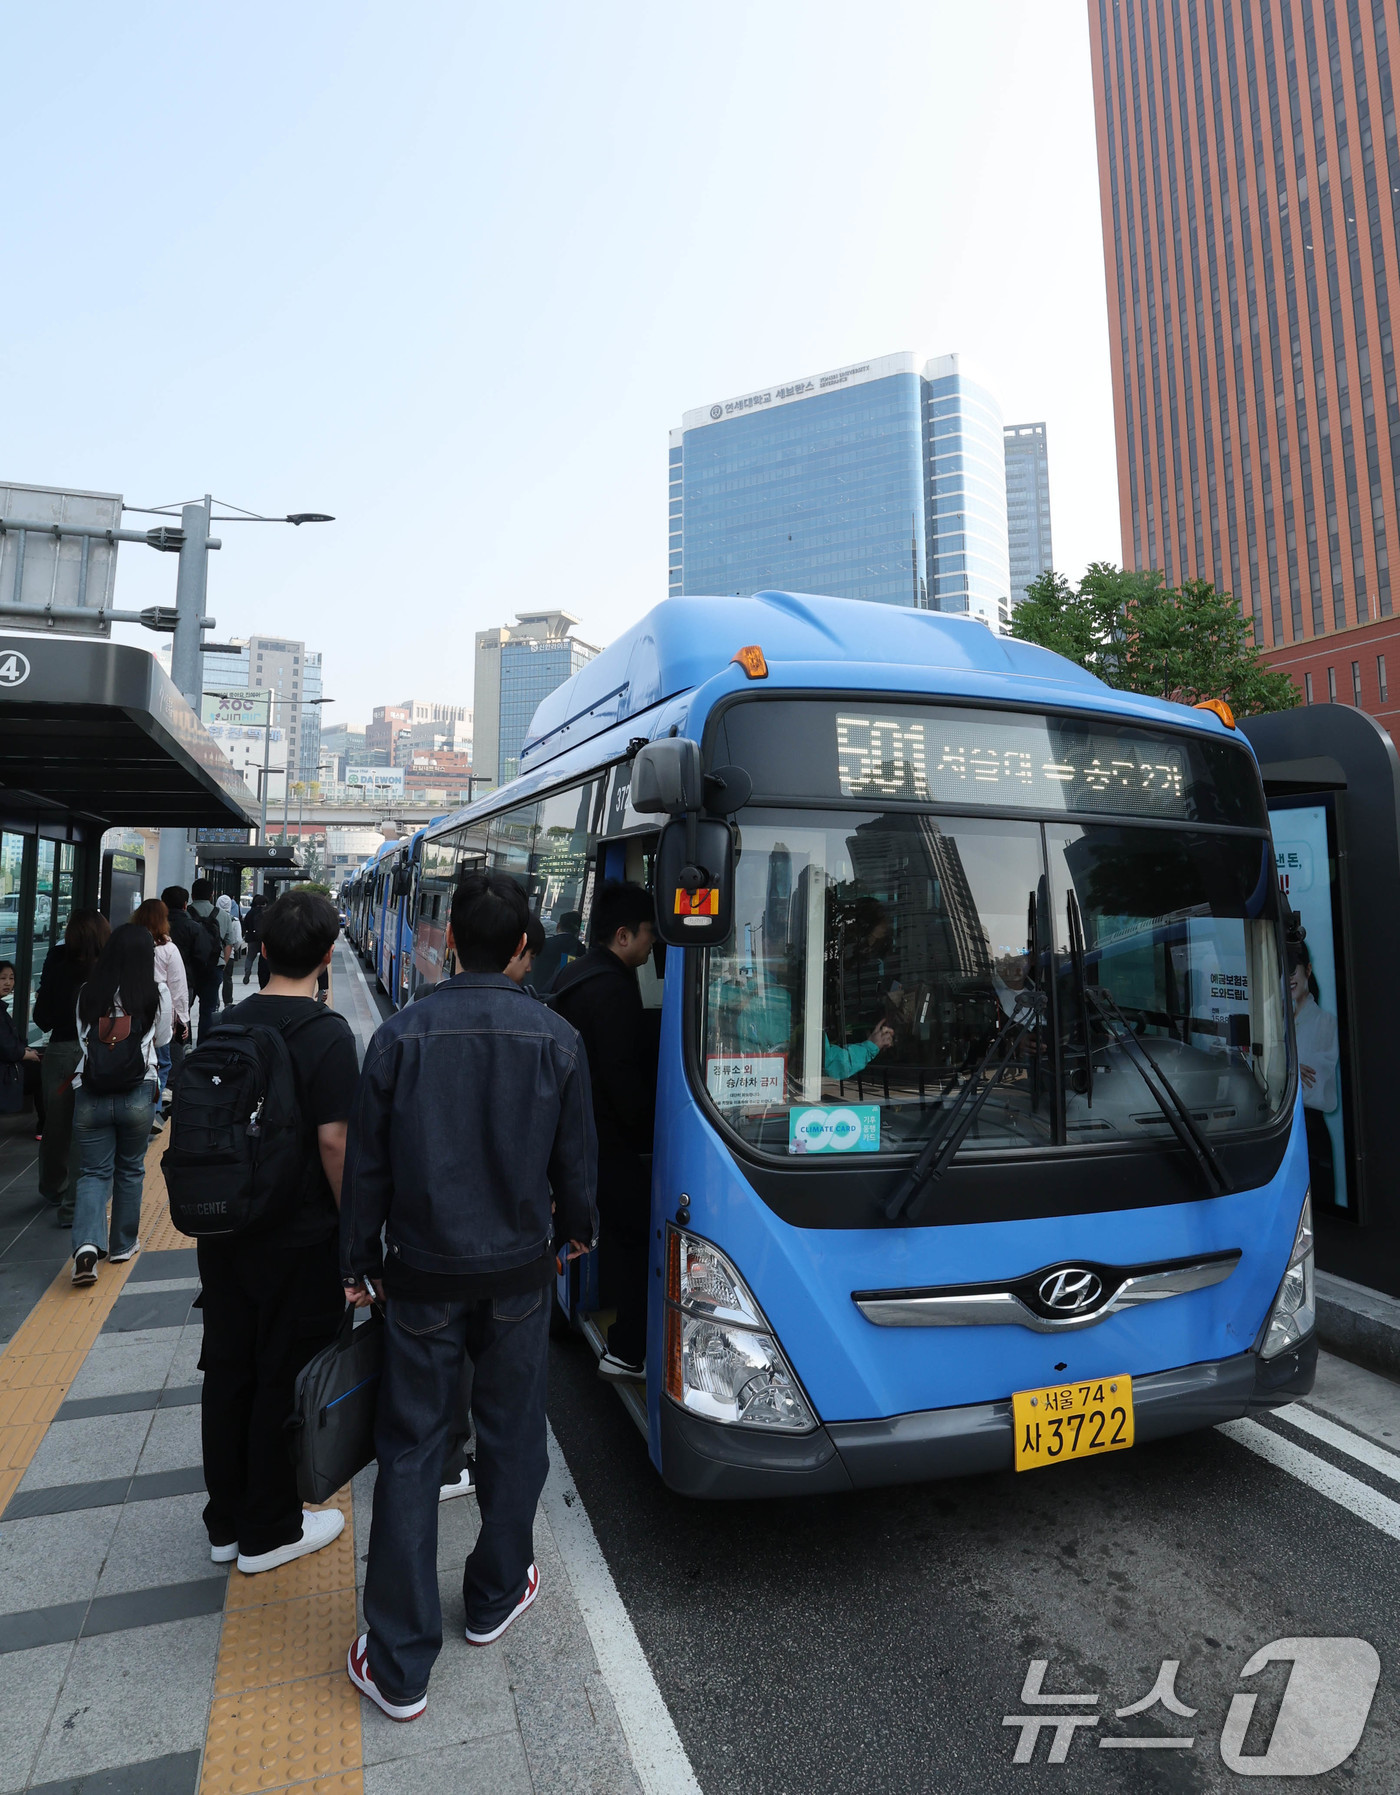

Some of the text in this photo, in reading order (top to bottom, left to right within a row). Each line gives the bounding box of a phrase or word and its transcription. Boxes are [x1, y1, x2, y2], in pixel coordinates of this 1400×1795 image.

[725, 381, 815, 414] 연세대학교 세브란스
[539, 642, 569, 651] 신한라이프
[836, 717, 928, 795] 501
[360, 775, 402, 785] DAEWON
[1287, 852, 1302, 870] 돈,
[714, 1065, 753, 1076] 정류소 외
[726, 1077, 778, 1089] 승/하차 금지
[864, 1116, 876, 1124] 기후
[1045, 1384, 1105, 1411] 서울 74
